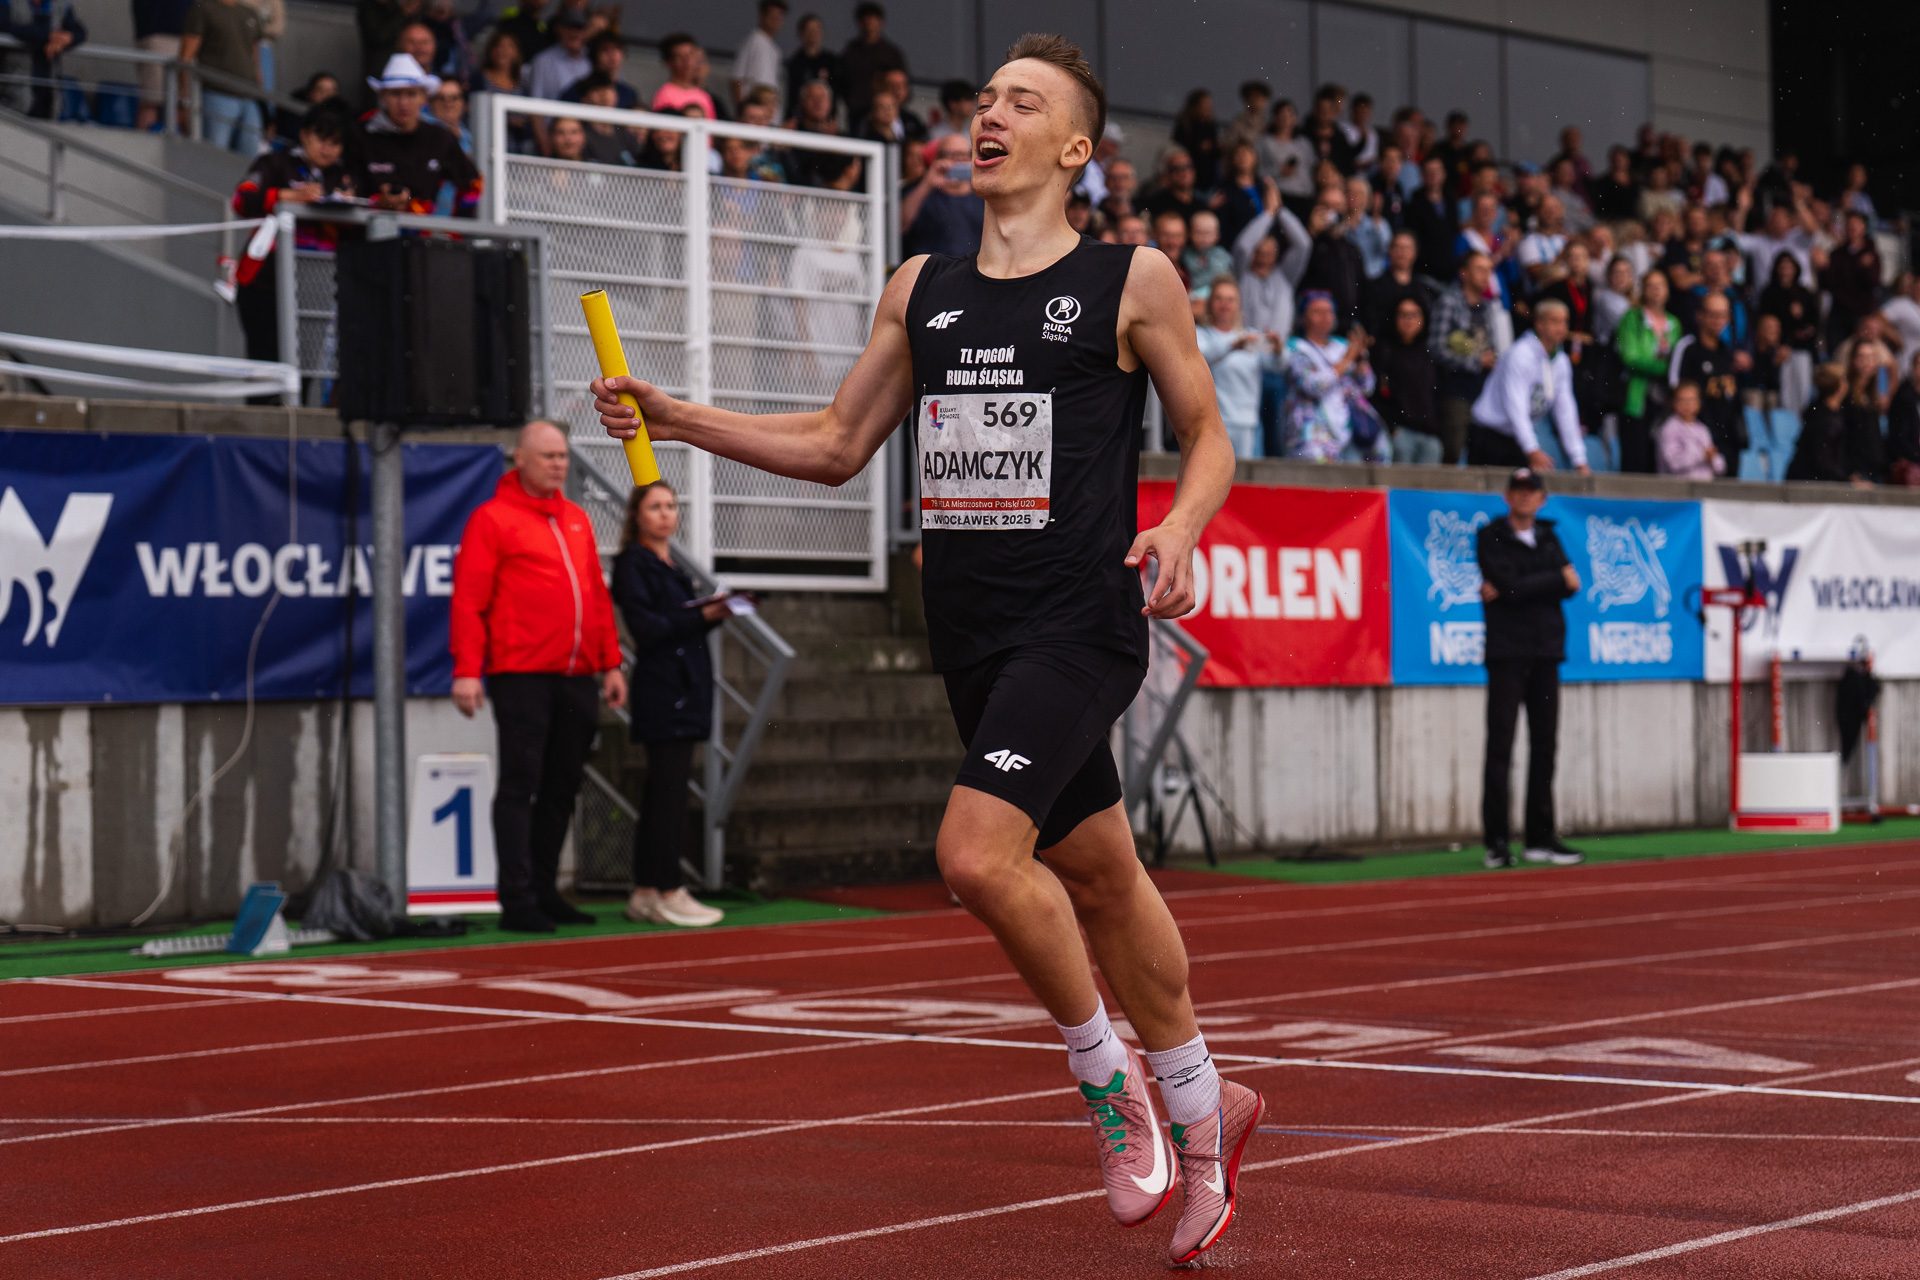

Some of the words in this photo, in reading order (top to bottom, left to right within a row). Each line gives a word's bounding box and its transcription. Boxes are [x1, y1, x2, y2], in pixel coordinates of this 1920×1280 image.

[926, 310, 964, 329] 4F
[1042, 322, 1073, 335] RUDA
[1041, 329, 1068, 343] Śląska
[960, 348, 973, 364] TL
[975, 345, 1016, 364] POGOŃ
[946, 370, 977, 386] RUDA
[978, 367, 1024, 387] ŚLĄSKA
[983, 402, 1038, 428] 569
[924, 451, 1045, 480] ADAMCZYK
[951, 500, 993, 508] Mistrzostwa
[995, 500, 1019, 508] Polski
[1020, 500, 1036, 508] U20
[934, 515, 999, 526] WOCŁAWEK
[1002, 514, 1032, 526] 2025
[136, 542, 460, 597] WŁOCŁAE
[984, 749, 1032, 772] 4F
[432, 786, 473, 877] 1
